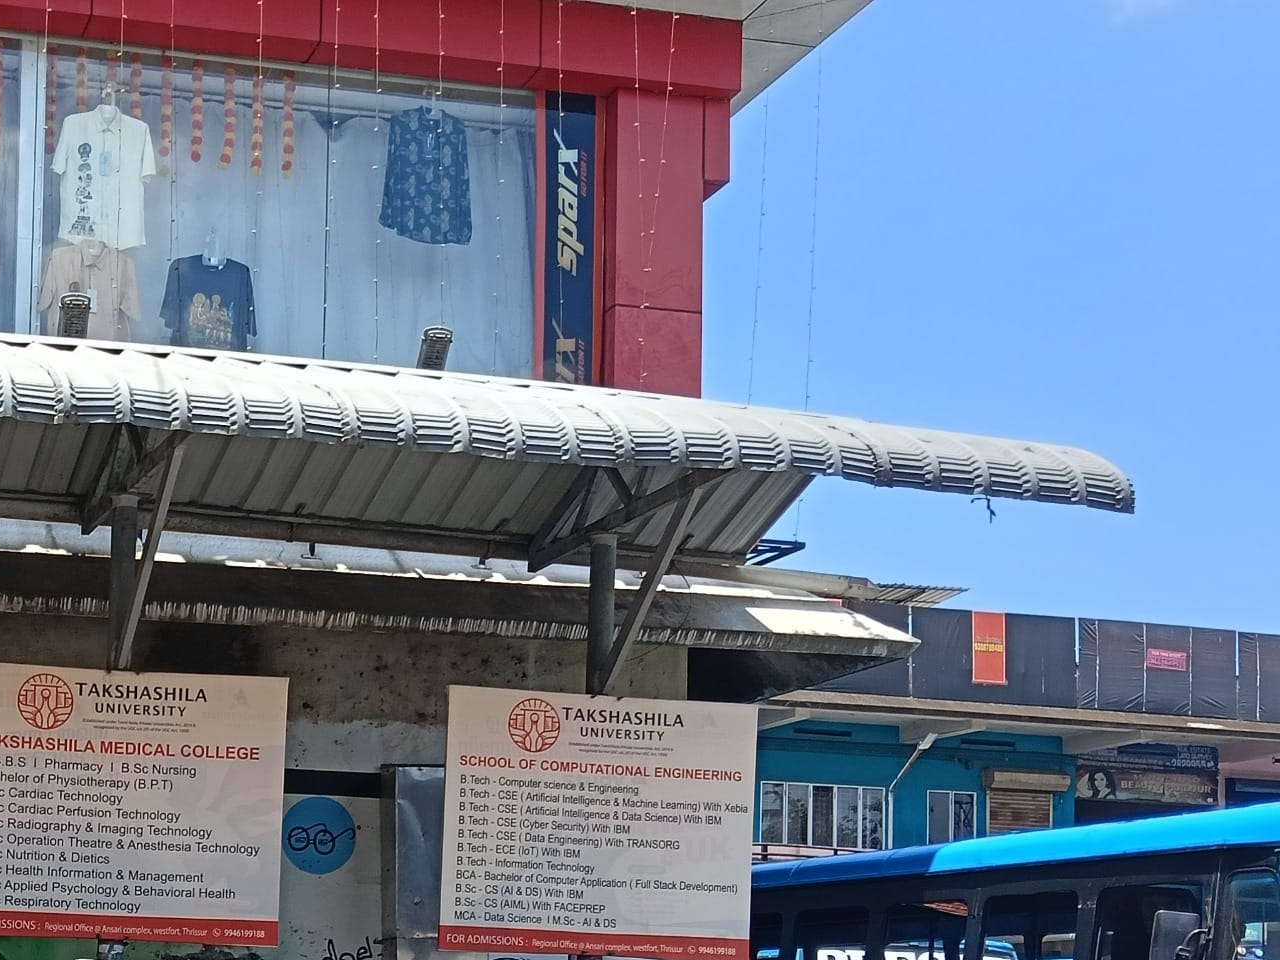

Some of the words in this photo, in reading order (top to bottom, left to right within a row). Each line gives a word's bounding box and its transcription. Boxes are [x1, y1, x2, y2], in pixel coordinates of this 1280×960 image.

[553, 127, 584, 277] sparx
[75, 682, 208, 703] TAKSHASHILA
[95, 702, 187, 717] UNIVERSITY
[562, 707, 684, 728] TAKSHASHILA
[580, 727, 665, 741] UNIVERSITY
[100, 740, 175, 757] MEDICAL
[180, 744, 260, 760] COLLEGE
[44, 758, 103, 774] Pharmacy
[121, 762, 149, 774] B.Sc
[152, 763, 197, 778] Nursing
[459, 755, 515, 769] SCHOOL
[518, 758, 536, 771] OF
[540, 759, 650, 777] COMPUTATIONAL
[654, 767, 742, 782] ENGINEERING
[32, 773, 44, 784] of
[48, 774, 130, 791] Physiotherapy
[133, 779, 173, 793] (B.P.T)
[460, 775, 490, 786] B.Tech
[498, 776, 542, 790] Computer
[544, 780, 577, 791] science
[579, 781, 585, 791] &
[588, 782, 639, 796] Engineering
